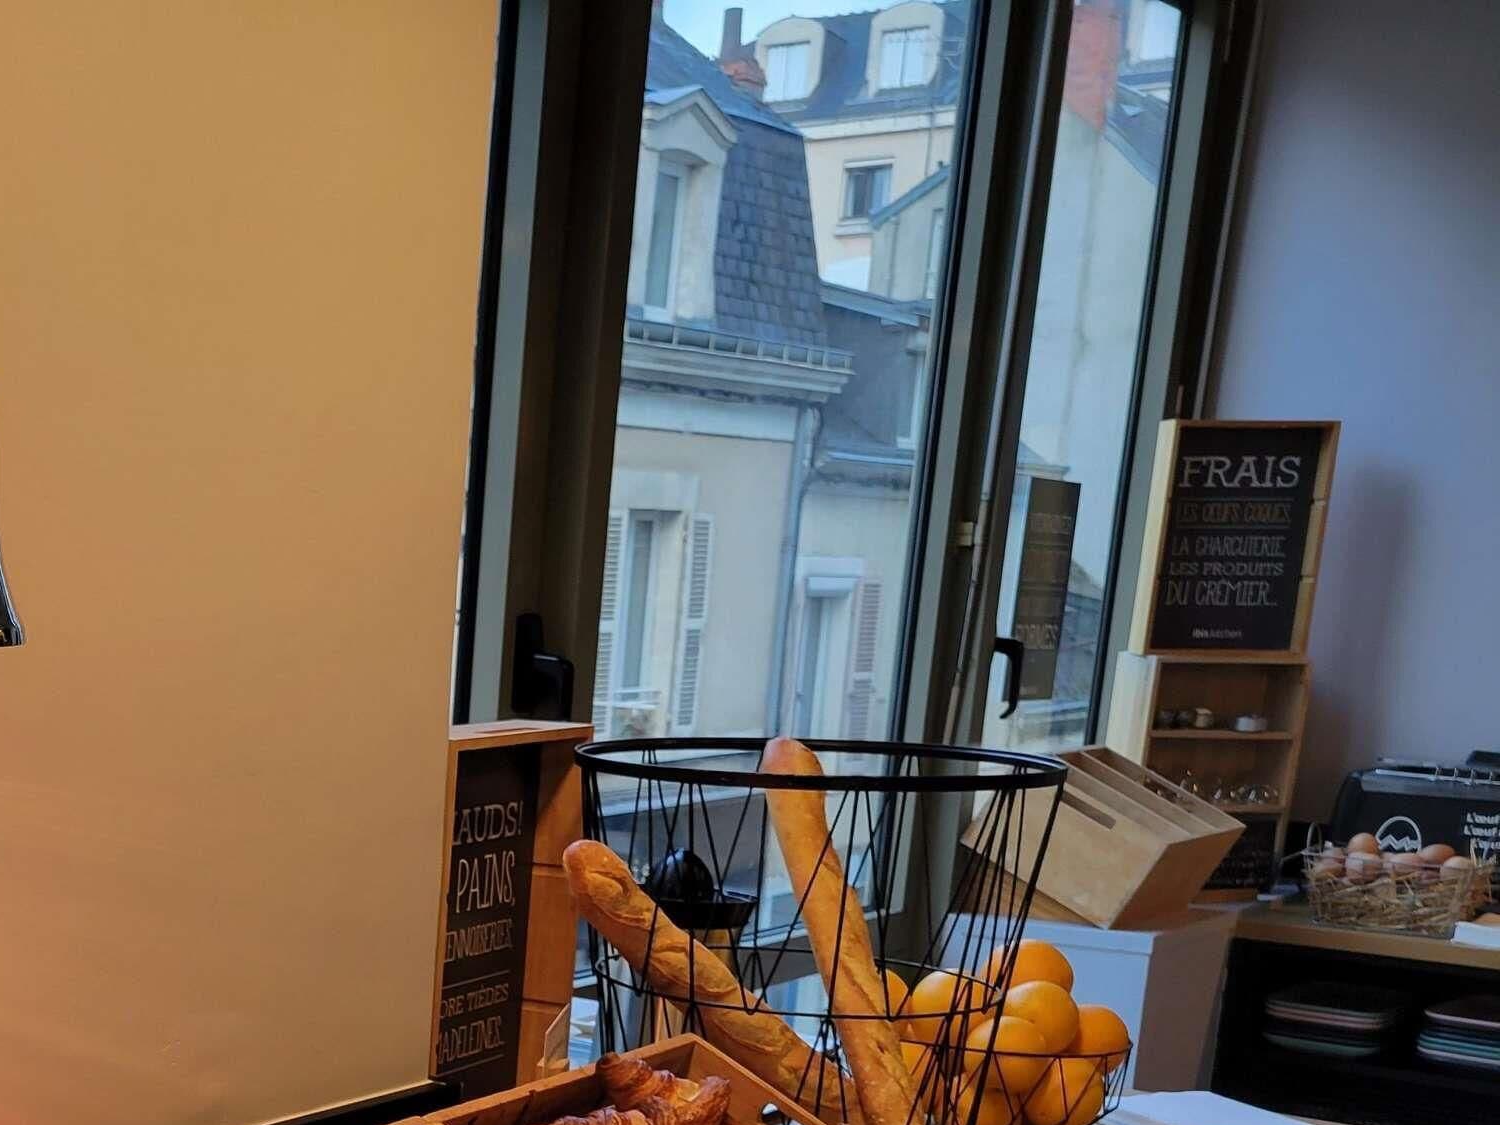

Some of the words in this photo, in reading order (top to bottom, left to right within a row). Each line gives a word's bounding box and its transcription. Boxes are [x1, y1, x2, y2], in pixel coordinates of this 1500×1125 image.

[1179, 456, 1302, 488] FRAIS
[1172, 536, 1189, 557] LA
[1169, 562, 1199, 576] LES
[1202, 562, 1285, 576] PRODUITS
[1164, 580, 1190, 606] DU
[451, 800, 523, 847] AUDS!
